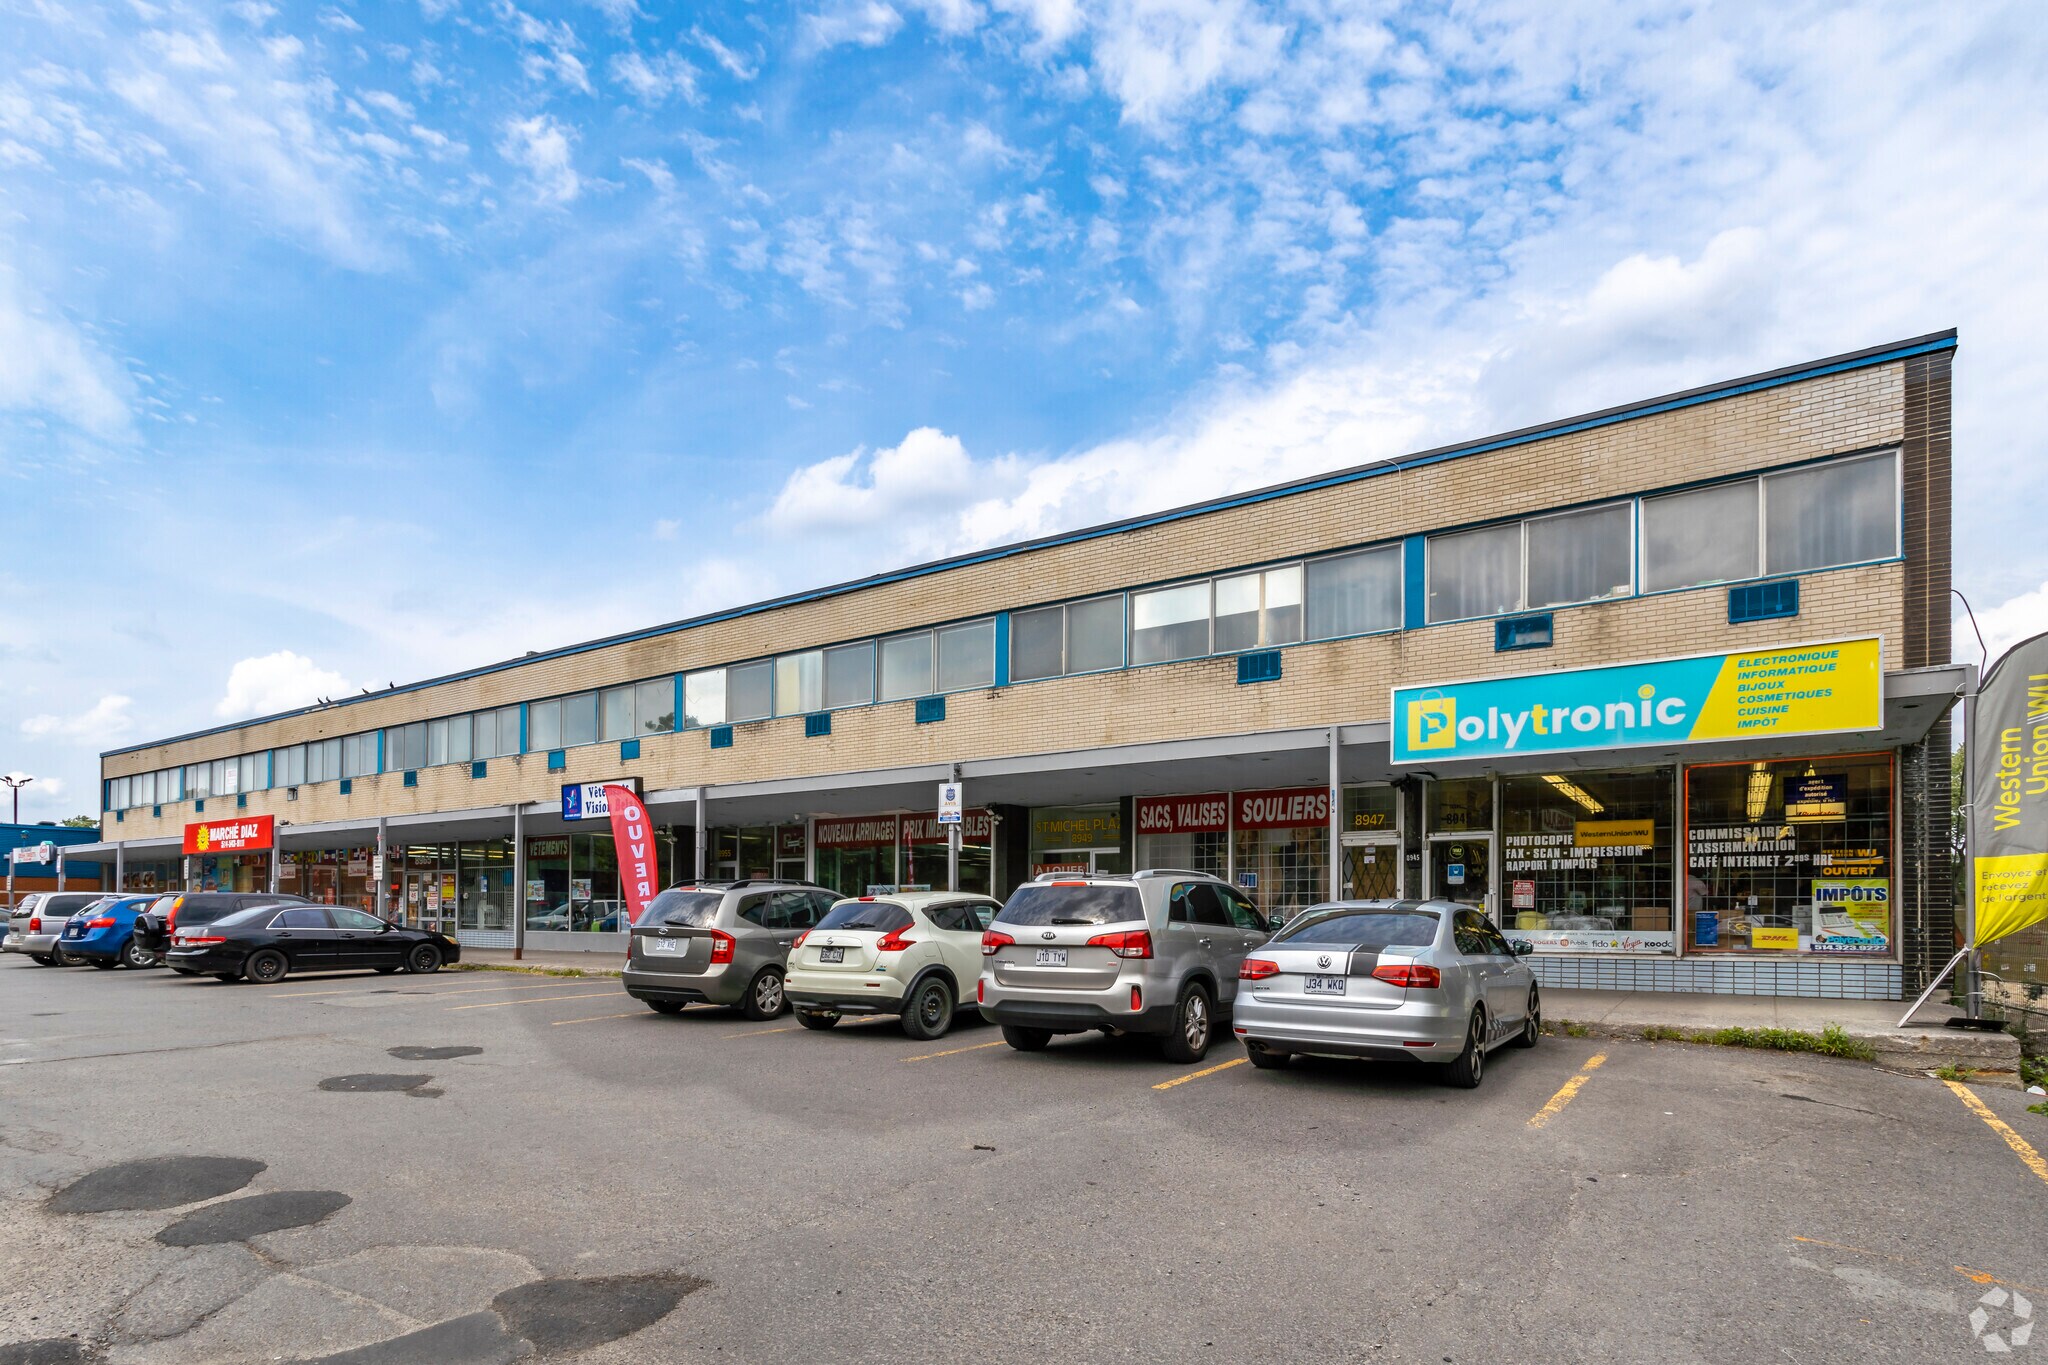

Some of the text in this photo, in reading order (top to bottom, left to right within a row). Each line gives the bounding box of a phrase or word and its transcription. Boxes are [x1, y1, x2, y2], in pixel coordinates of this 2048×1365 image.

[1738, 650, 1839, 668] ÉLECTRONIQUE
[1738, 663, 1837, 680] INFORMATIQUE
[1738, 681, 1785, 692] BIJOUX
[1738, 689, 1832, 704] COSMETIQUES
[1419, 684, 1686, 749] Polytronic
[1738, 705, 1789, 716] CUISINE
[1738, 717, 1779, 728] IMPÔT
[1994, 727, 2021, 831] Western
[1242, 794, 1327, 824] SOULIERS
[1140, 801, 1226, 832] SACS, VALISES
[1355, 814, 1385, 826] 8947
[210, 822, 258, 841] MARCHÉ DIAZ
[817, 823, 855, 844] NOUVEAUX
[855, 820, 896, 841] ARRIVAGES
[903, 818, 927, 840] PRIX
[926, 815, 990, 839] IMBAABLES
[1050, 819, 1091, 833] MICHEL
[1071, 833, 1093, 843] 8949
[1506, 834, 1573, 847] PHOTOCOPIE
[1506, 848, 1525, 859] FAX
[1533, 847, 1560, 859] SCAN
[1570, 845, 1643, 858] IMPRESSION
[1689, 839, 1796, 854] L'ASSERMENTATION
[1506, 856, 1598, 872] RAPPORT D'IMPÔTS
[1689, 854, 1719, 868] CAFÉ
[1723, 855, 1780, 868] INTERNET
[1813, 854, 1833, 866] HRE
[1823, 867, 1876, 875] OUVERT
[1982, 868, 2047, 880] Envoyez et
[1982, 882, 2029, 891] recevez
[1815, 886, 1887, 902] IMPÔTS
[1982, 895, 1996, 903] de
[1592, 940, 1609, 948] fido
[1306, 979, 1344, 990] J34 WKQ
